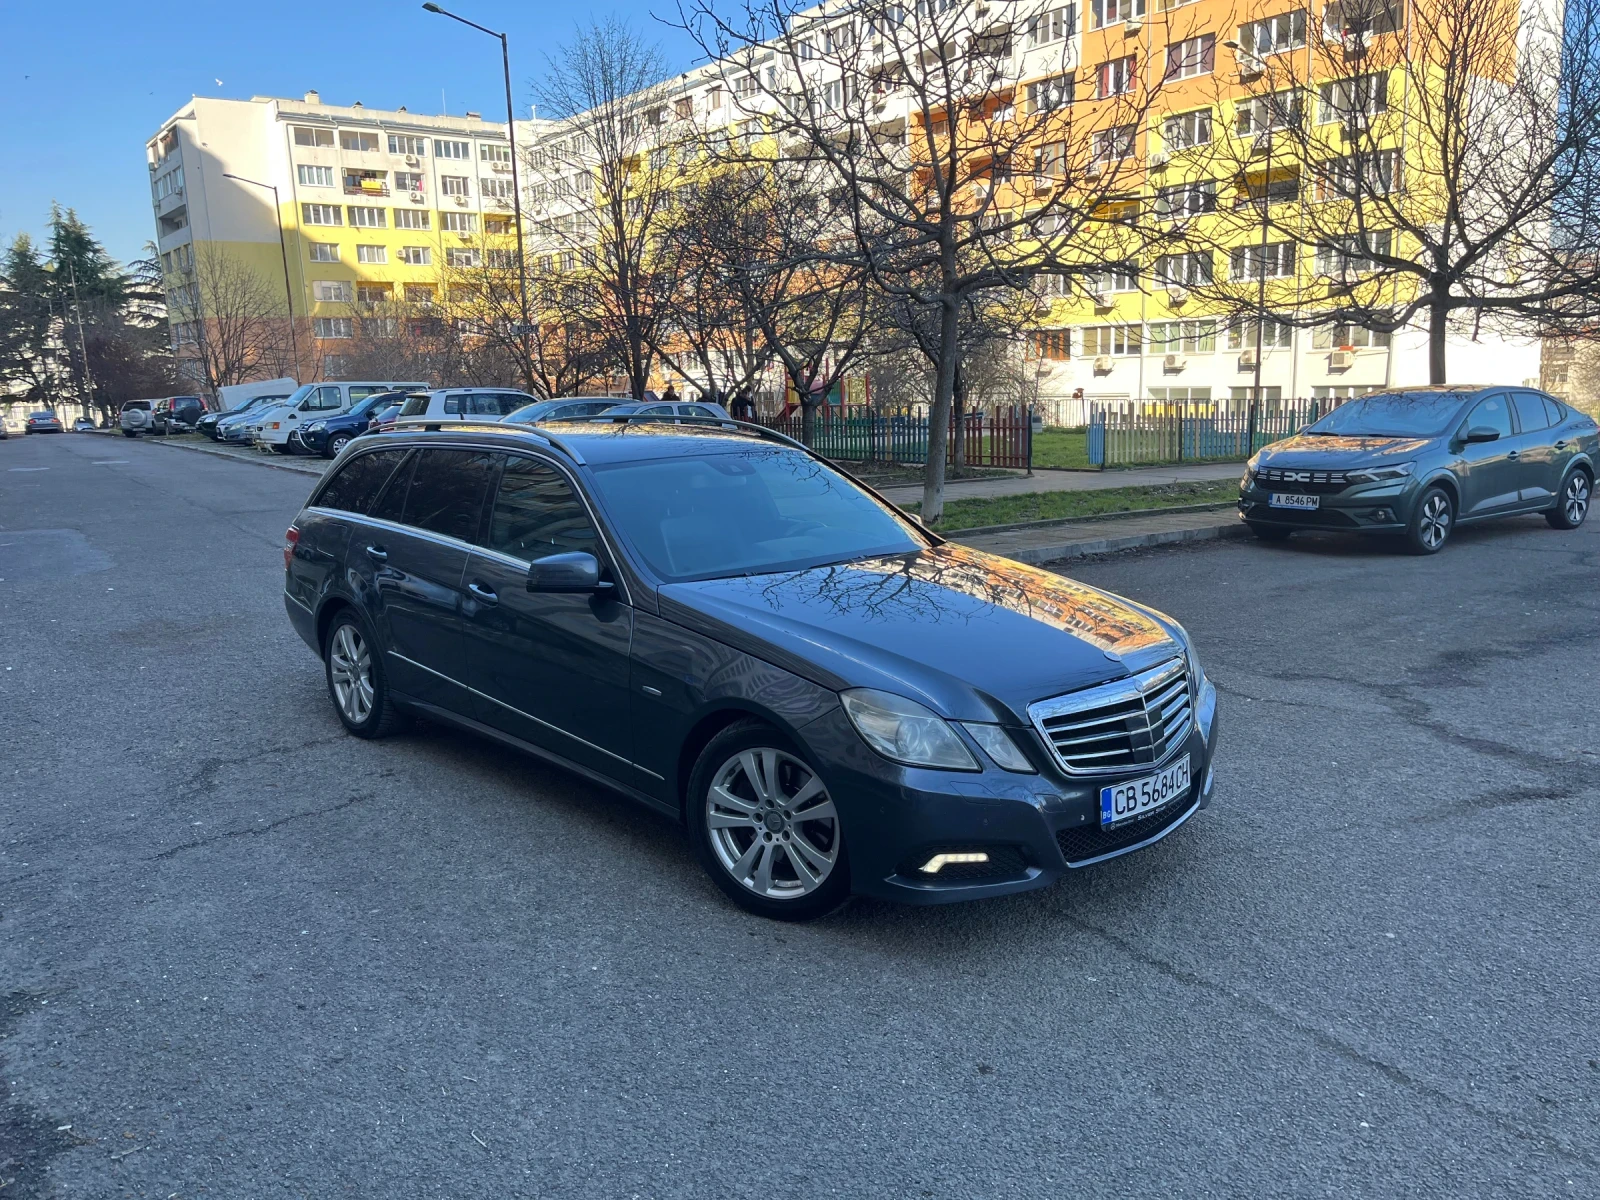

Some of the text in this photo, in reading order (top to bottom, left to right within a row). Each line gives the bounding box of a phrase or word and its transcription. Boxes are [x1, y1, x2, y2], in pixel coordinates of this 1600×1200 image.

[1276, 495, 1318, 507] A 8546 PM
[1115, 785, 1138, 815] CB
[1141, 770, 1175, 807] 5684
[1176, 759, 1189, 789] CH
[1102, 810, 1112, 820] BG
